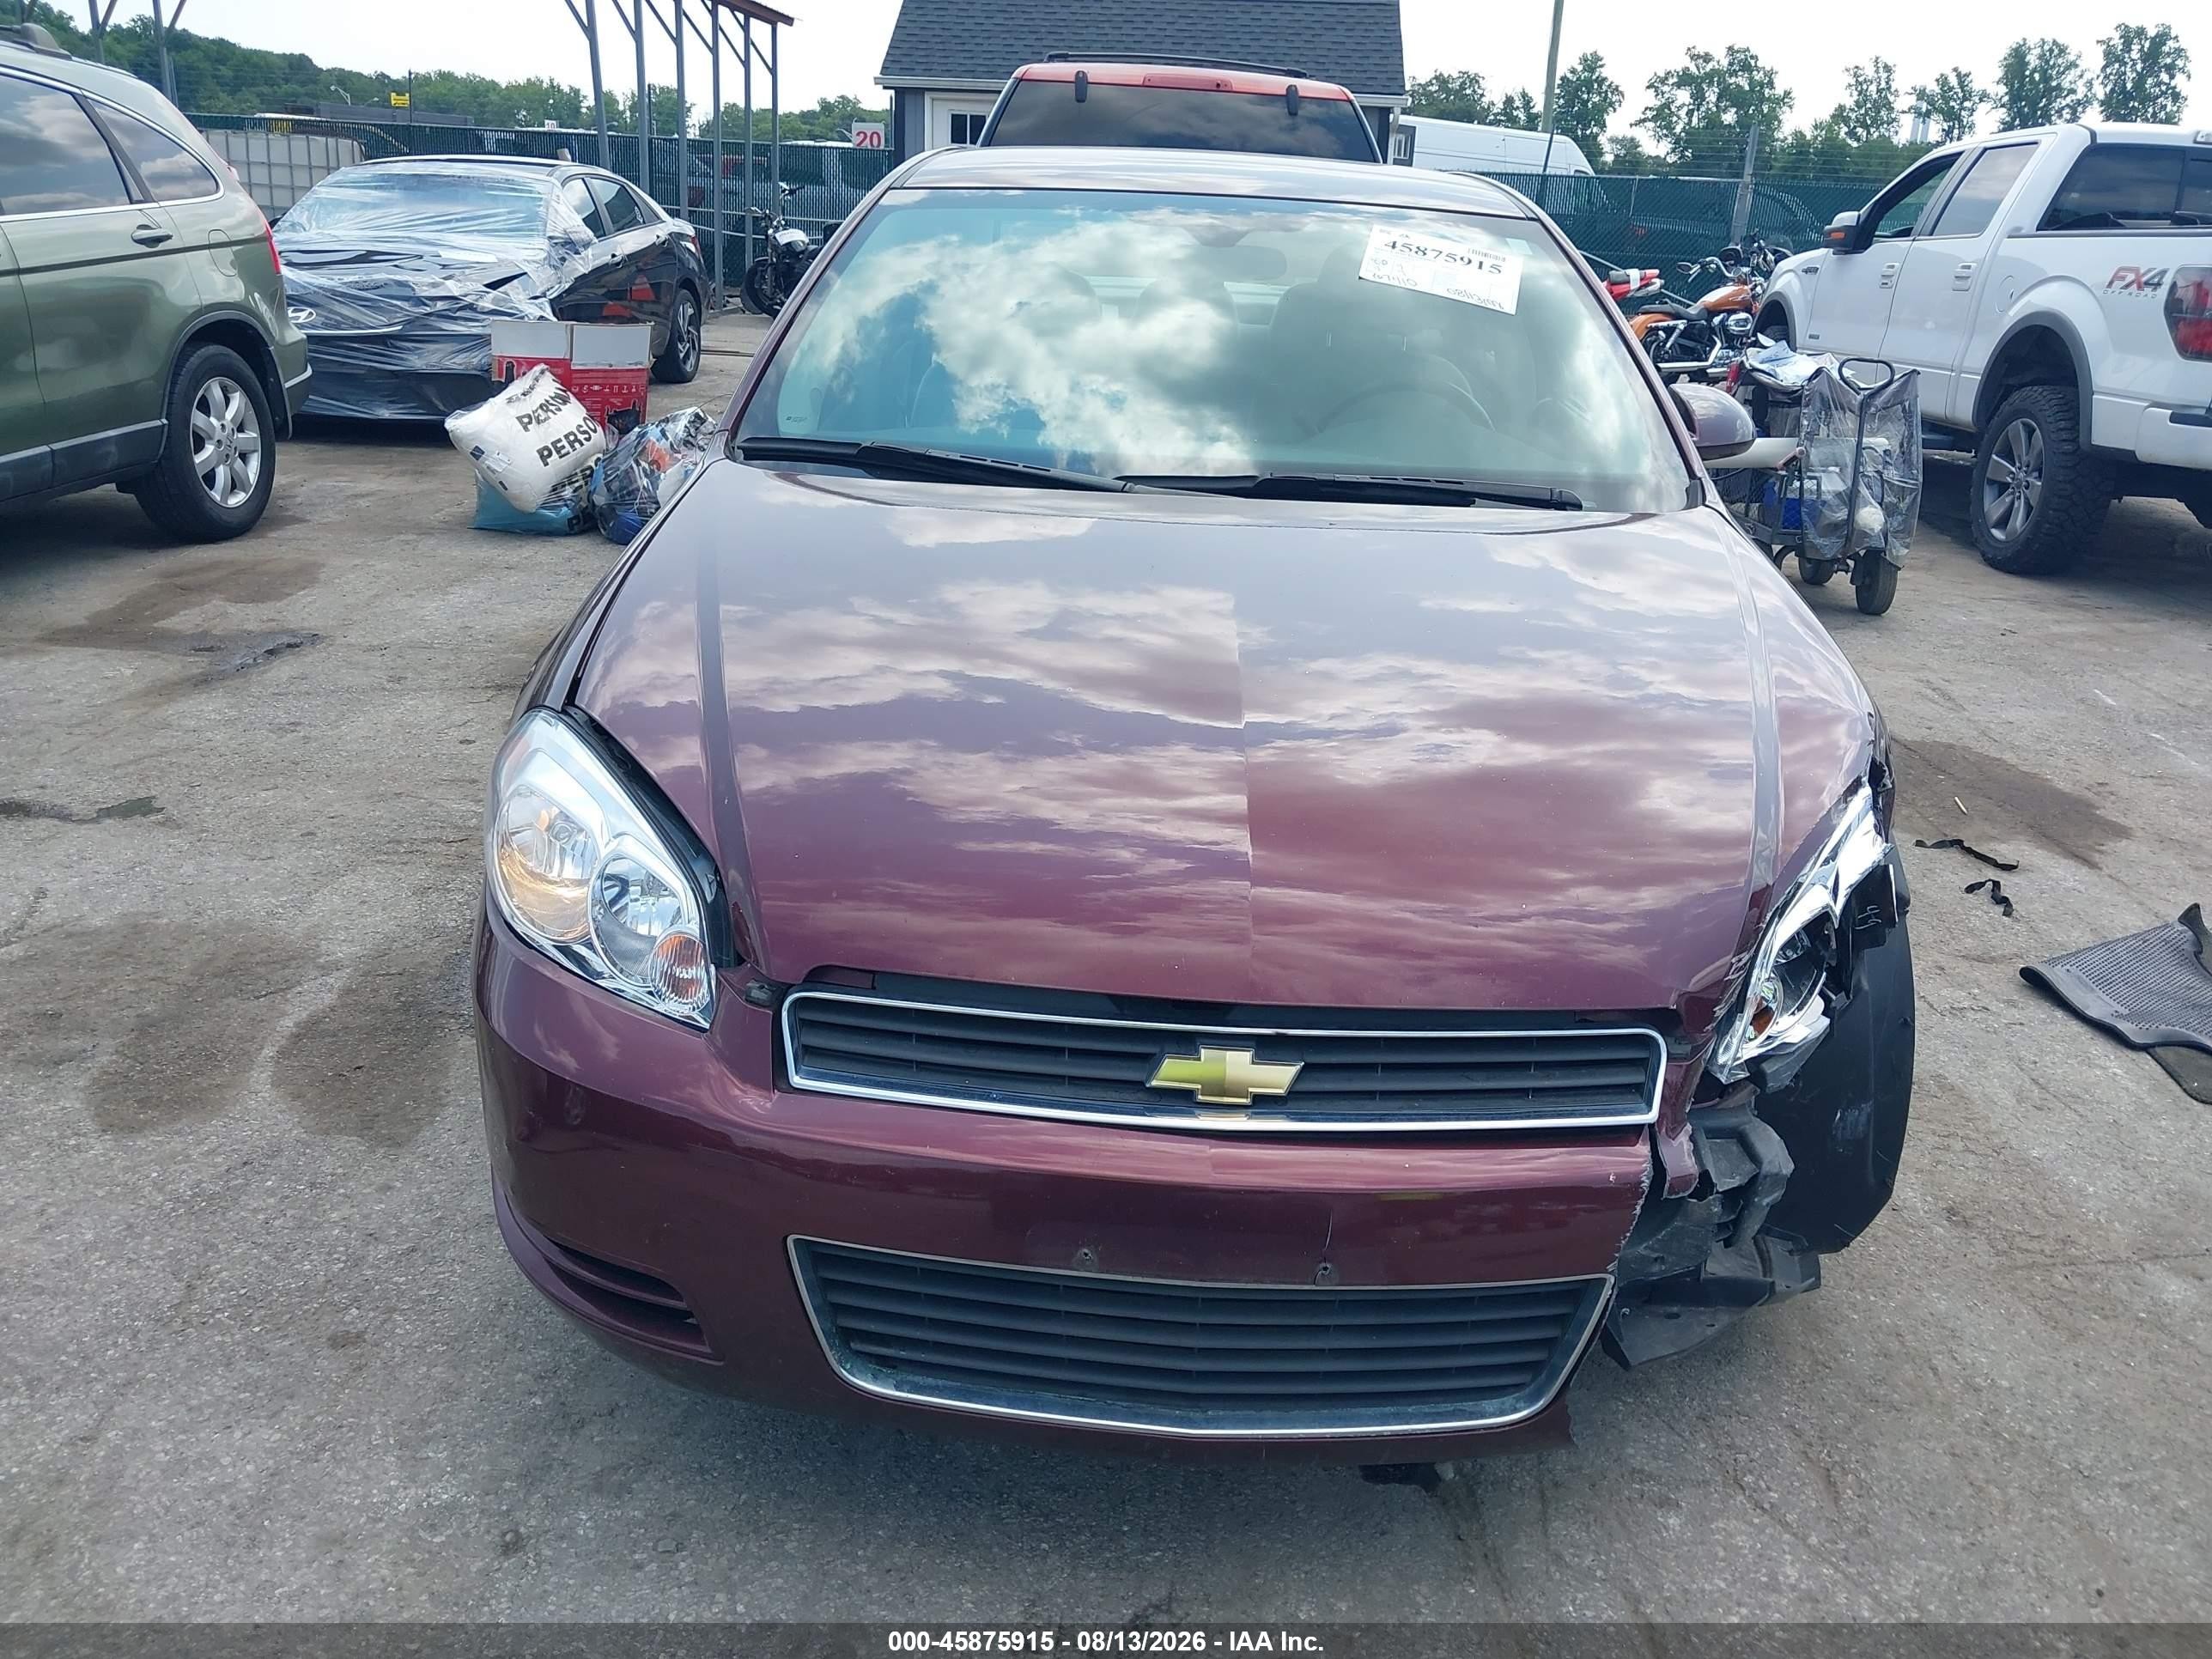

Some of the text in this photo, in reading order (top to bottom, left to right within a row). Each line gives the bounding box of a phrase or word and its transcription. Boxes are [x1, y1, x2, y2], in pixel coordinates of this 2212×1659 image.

[856, 131, 881, 148] 20
[1384, 240, 1503, 275] 45875915
[2106, 266, 2170, 292] FX4
